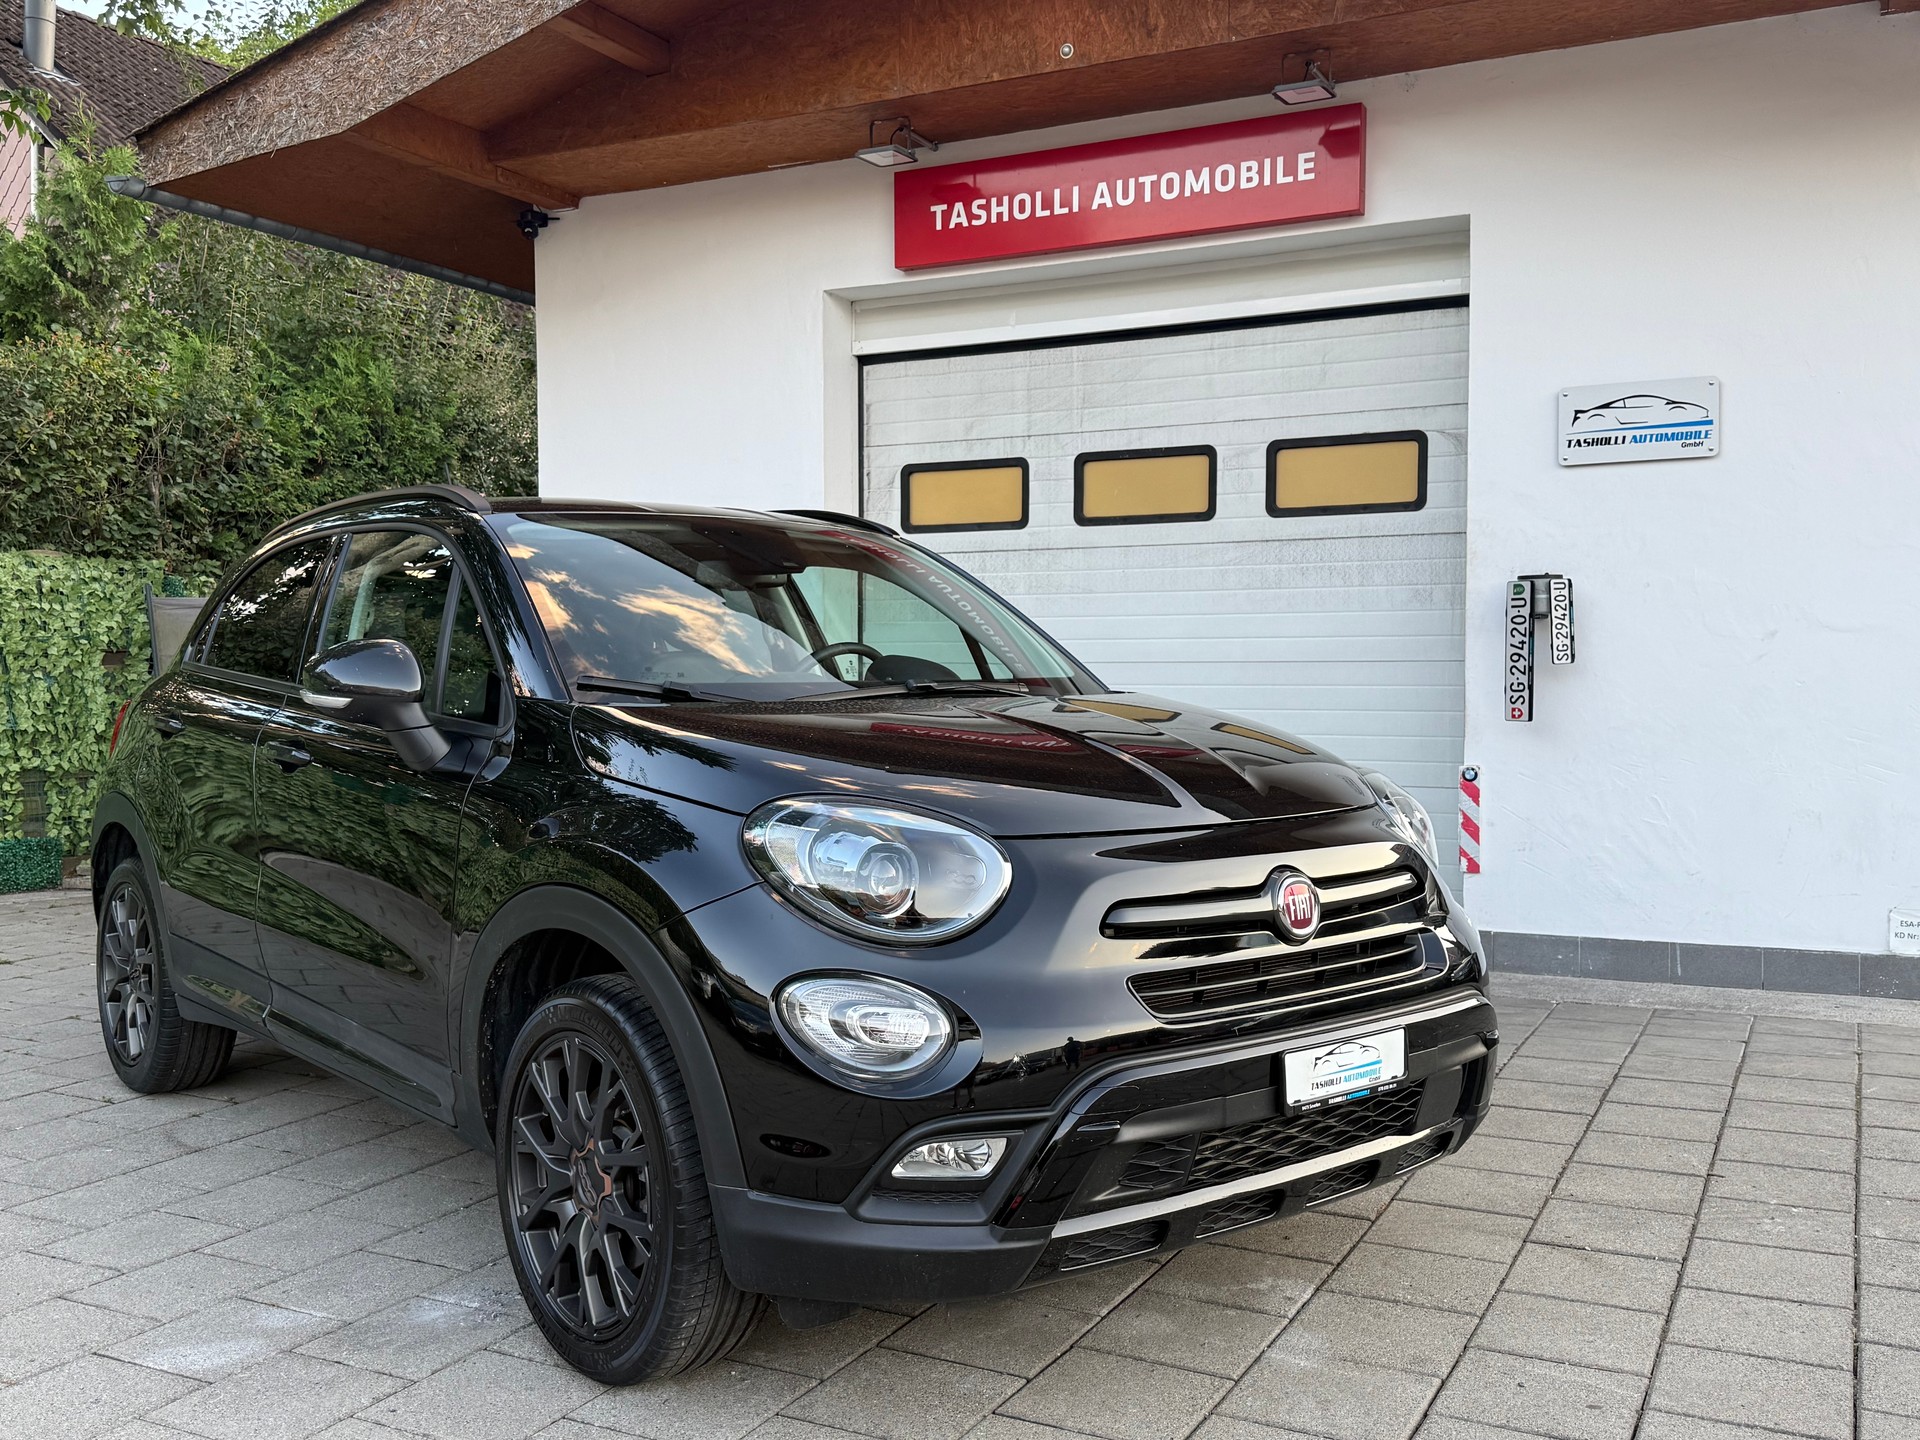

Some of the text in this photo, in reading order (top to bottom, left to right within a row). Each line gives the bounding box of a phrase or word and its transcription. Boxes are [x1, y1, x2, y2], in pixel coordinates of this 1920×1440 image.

[930, 151, 1317, 231] TASHOLLI AUTOMOBILE
[1566, 429, 1713, 449] TASHOLLI AUTOMOBILE
[1680, 440, 1705, 449] GmbH
[1288, 893, 1312, 921] FIAT
[1894, 931, 1906, 939] KD
[1311, 1076, 1342, 1091] TASHOLLI
